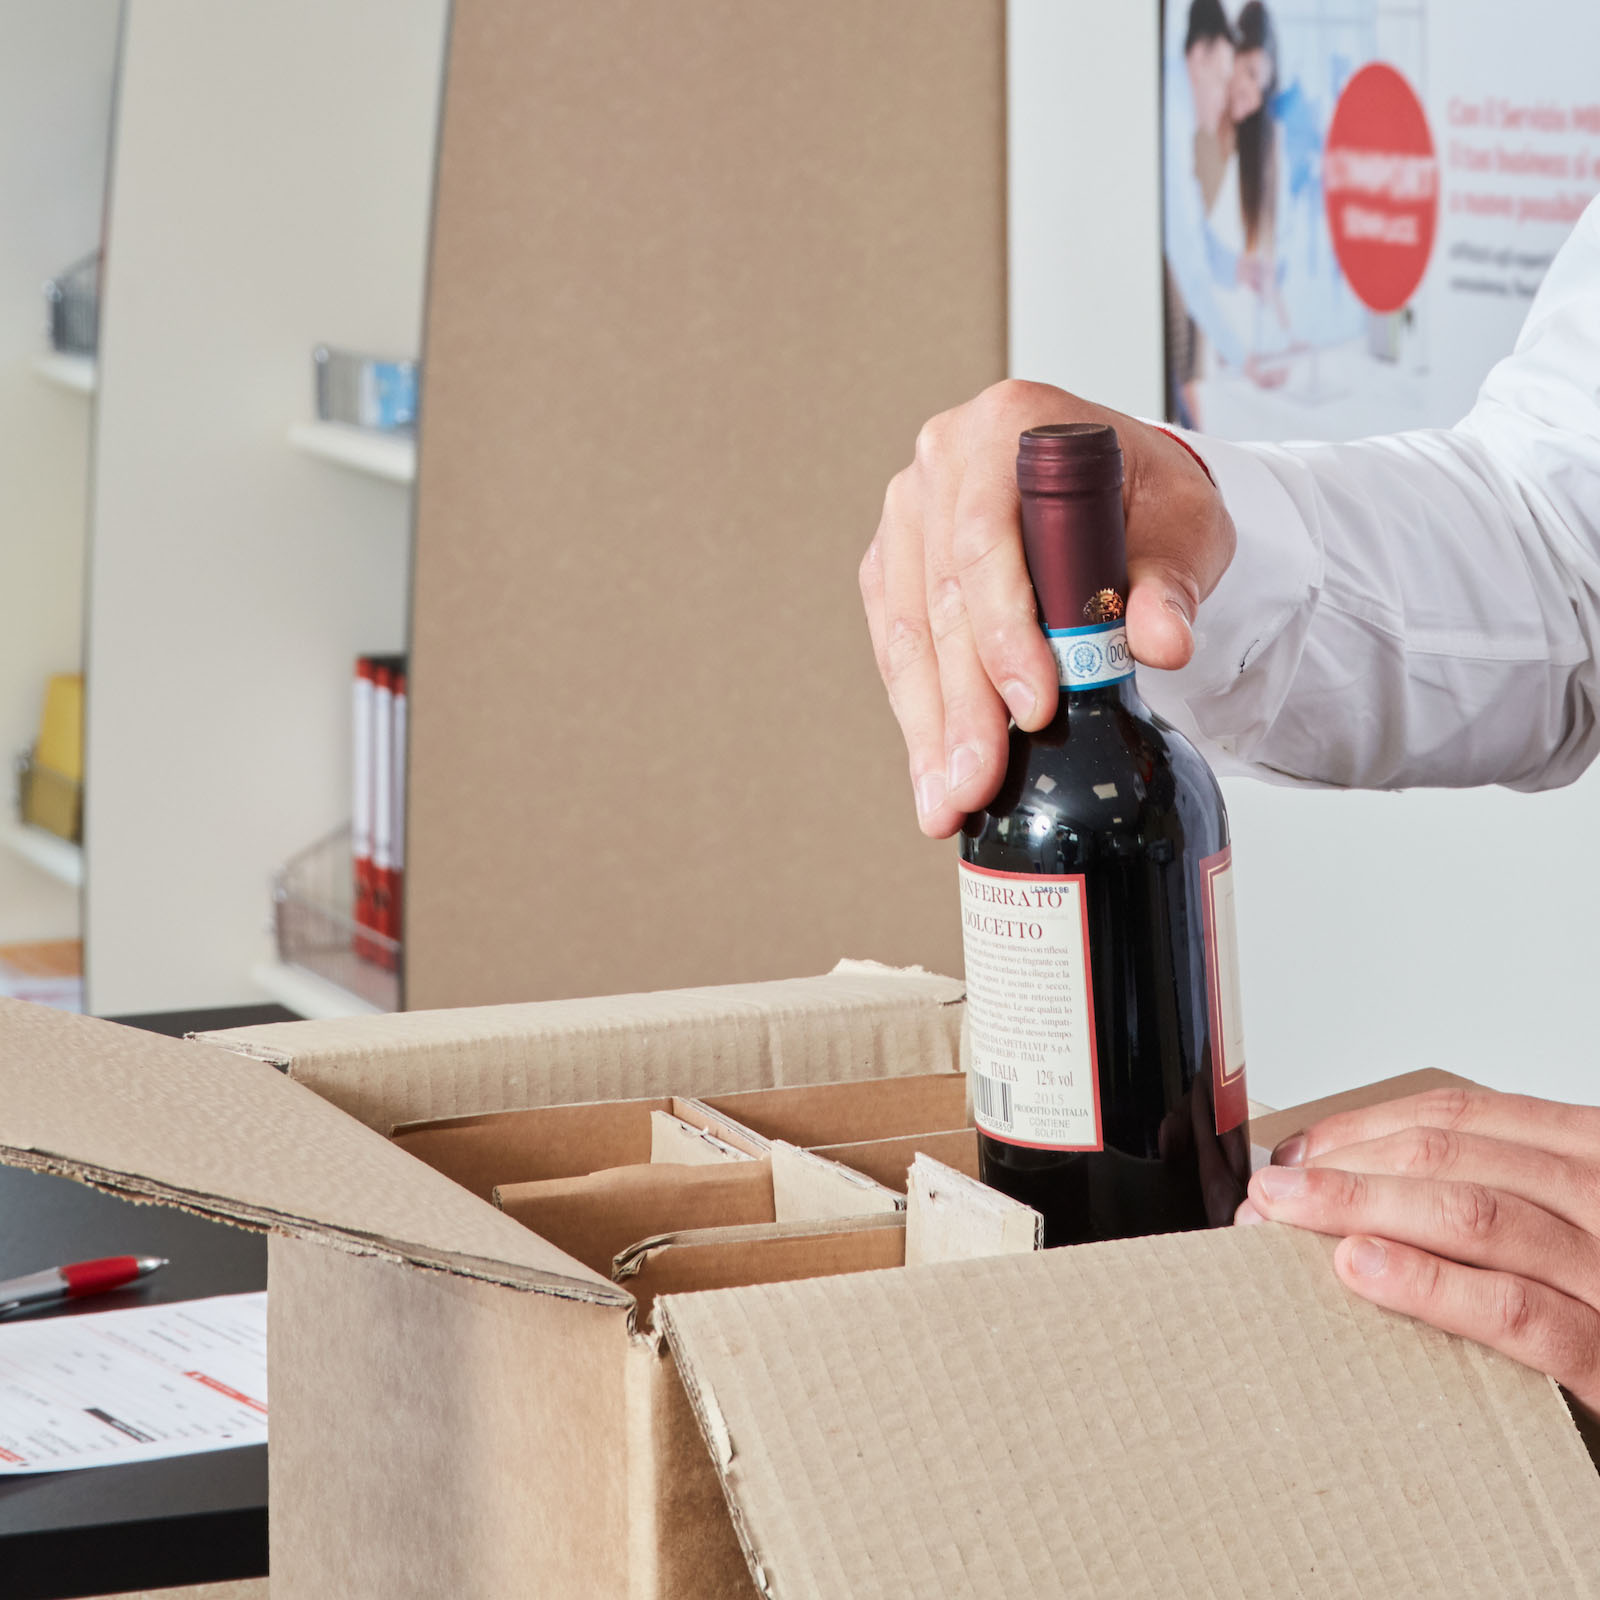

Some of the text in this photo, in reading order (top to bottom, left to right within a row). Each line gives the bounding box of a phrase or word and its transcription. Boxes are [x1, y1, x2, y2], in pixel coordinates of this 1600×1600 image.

[960, 878, 1063, 909] ONFERRATO
[964, 907, 1043, 940] DOLCETTO
[1044, 944, 1068, 955] riflessi
[1023, 956, 1053, 967] fragrante
[1055, 959, 1069, 967] con
[1028, 968, 1055, 978] ciliegia
[1062, 970, 1070, 978] la
[1031, 993, 1071, 1003] retrogusto
[1064, 1005, 1072, 1014] lo
[1047, 1029, 1072, 1041] tempo
[1021, 1051, 1045, 1062] ITALIA
[990, 1061, 1074, 1087] ITALIA 12% vol
[1014, 1103, 1089, 1118] PRODOTTO IN ITALIA
[1029, 1118, 1071, 1129] CONTIENE
[1034, 1128, 1066, 1139] SOLFITI
